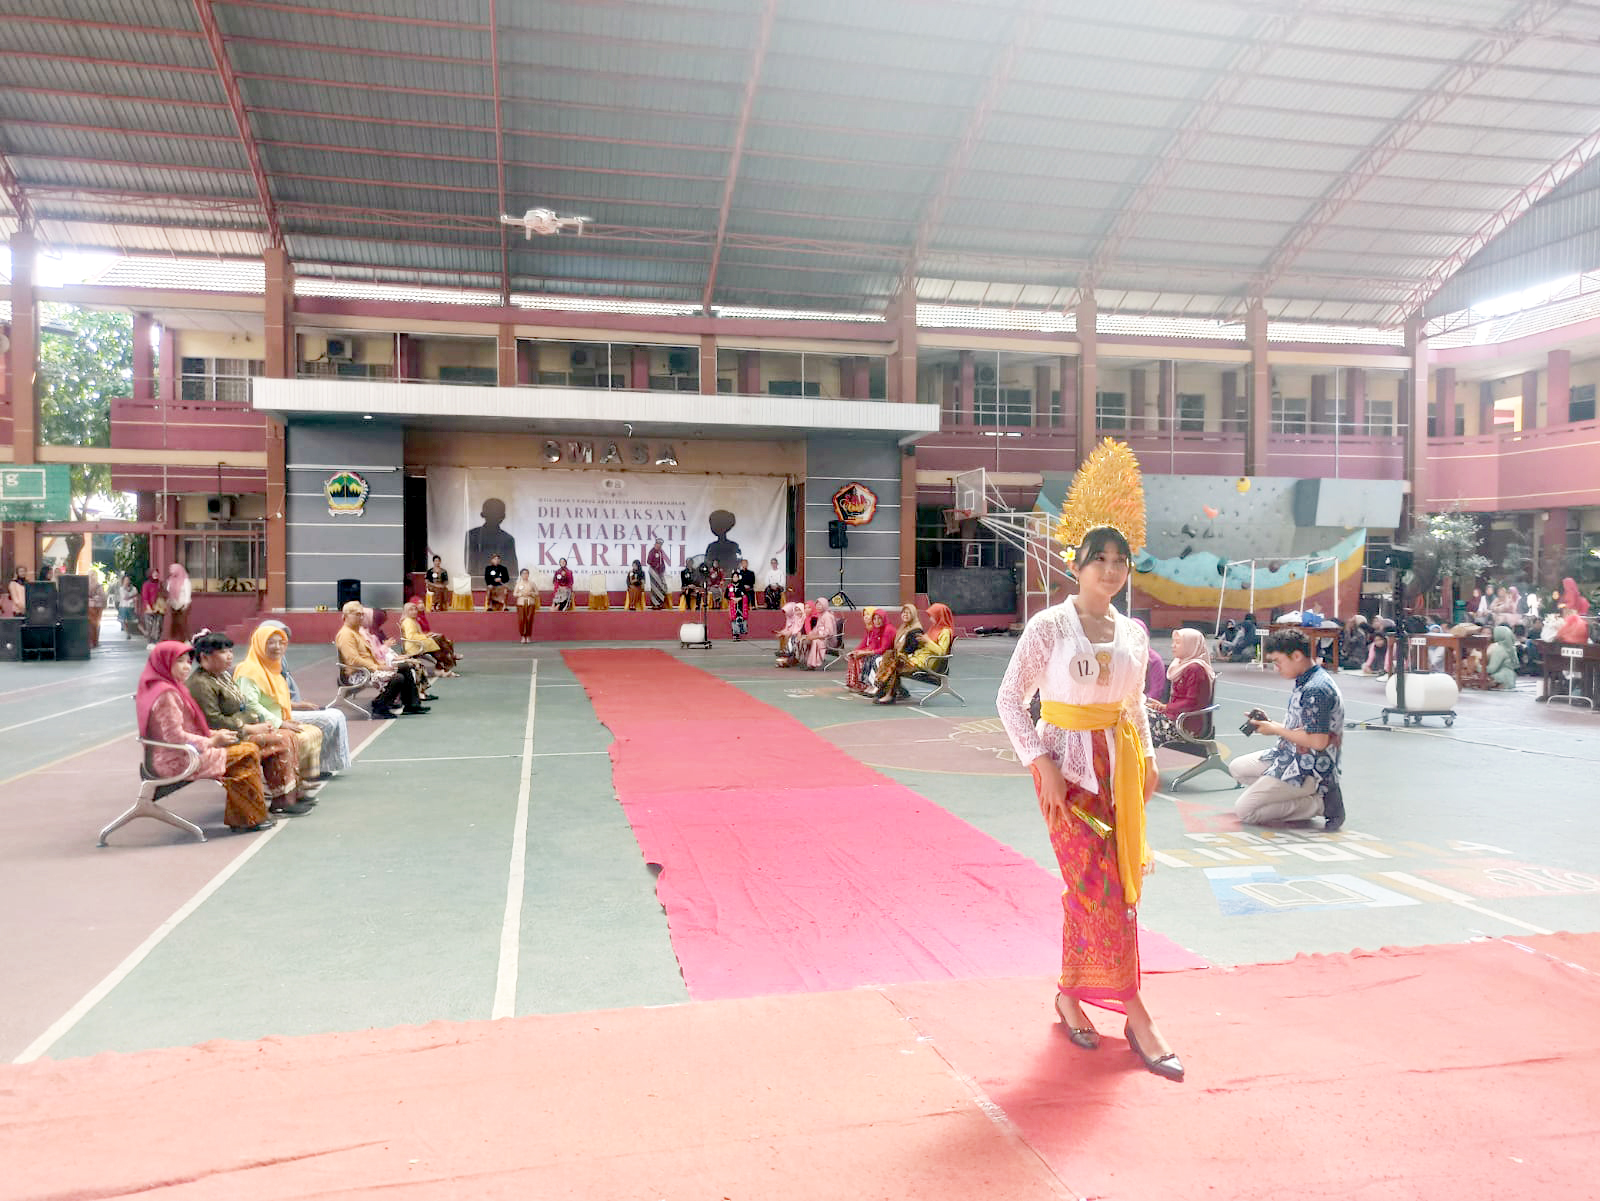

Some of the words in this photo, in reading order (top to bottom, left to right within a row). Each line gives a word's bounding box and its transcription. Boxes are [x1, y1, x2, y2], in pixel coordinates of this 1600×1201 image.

[543, 440, 678, 466] SMASA
[538, 506, 687, 521] DHARMALAKSANA
[537, 522, 687, 541] MAHABAKTI
[537, 542, 687, 567] KARTINI
[1077, 659, 1094, 677] 12
